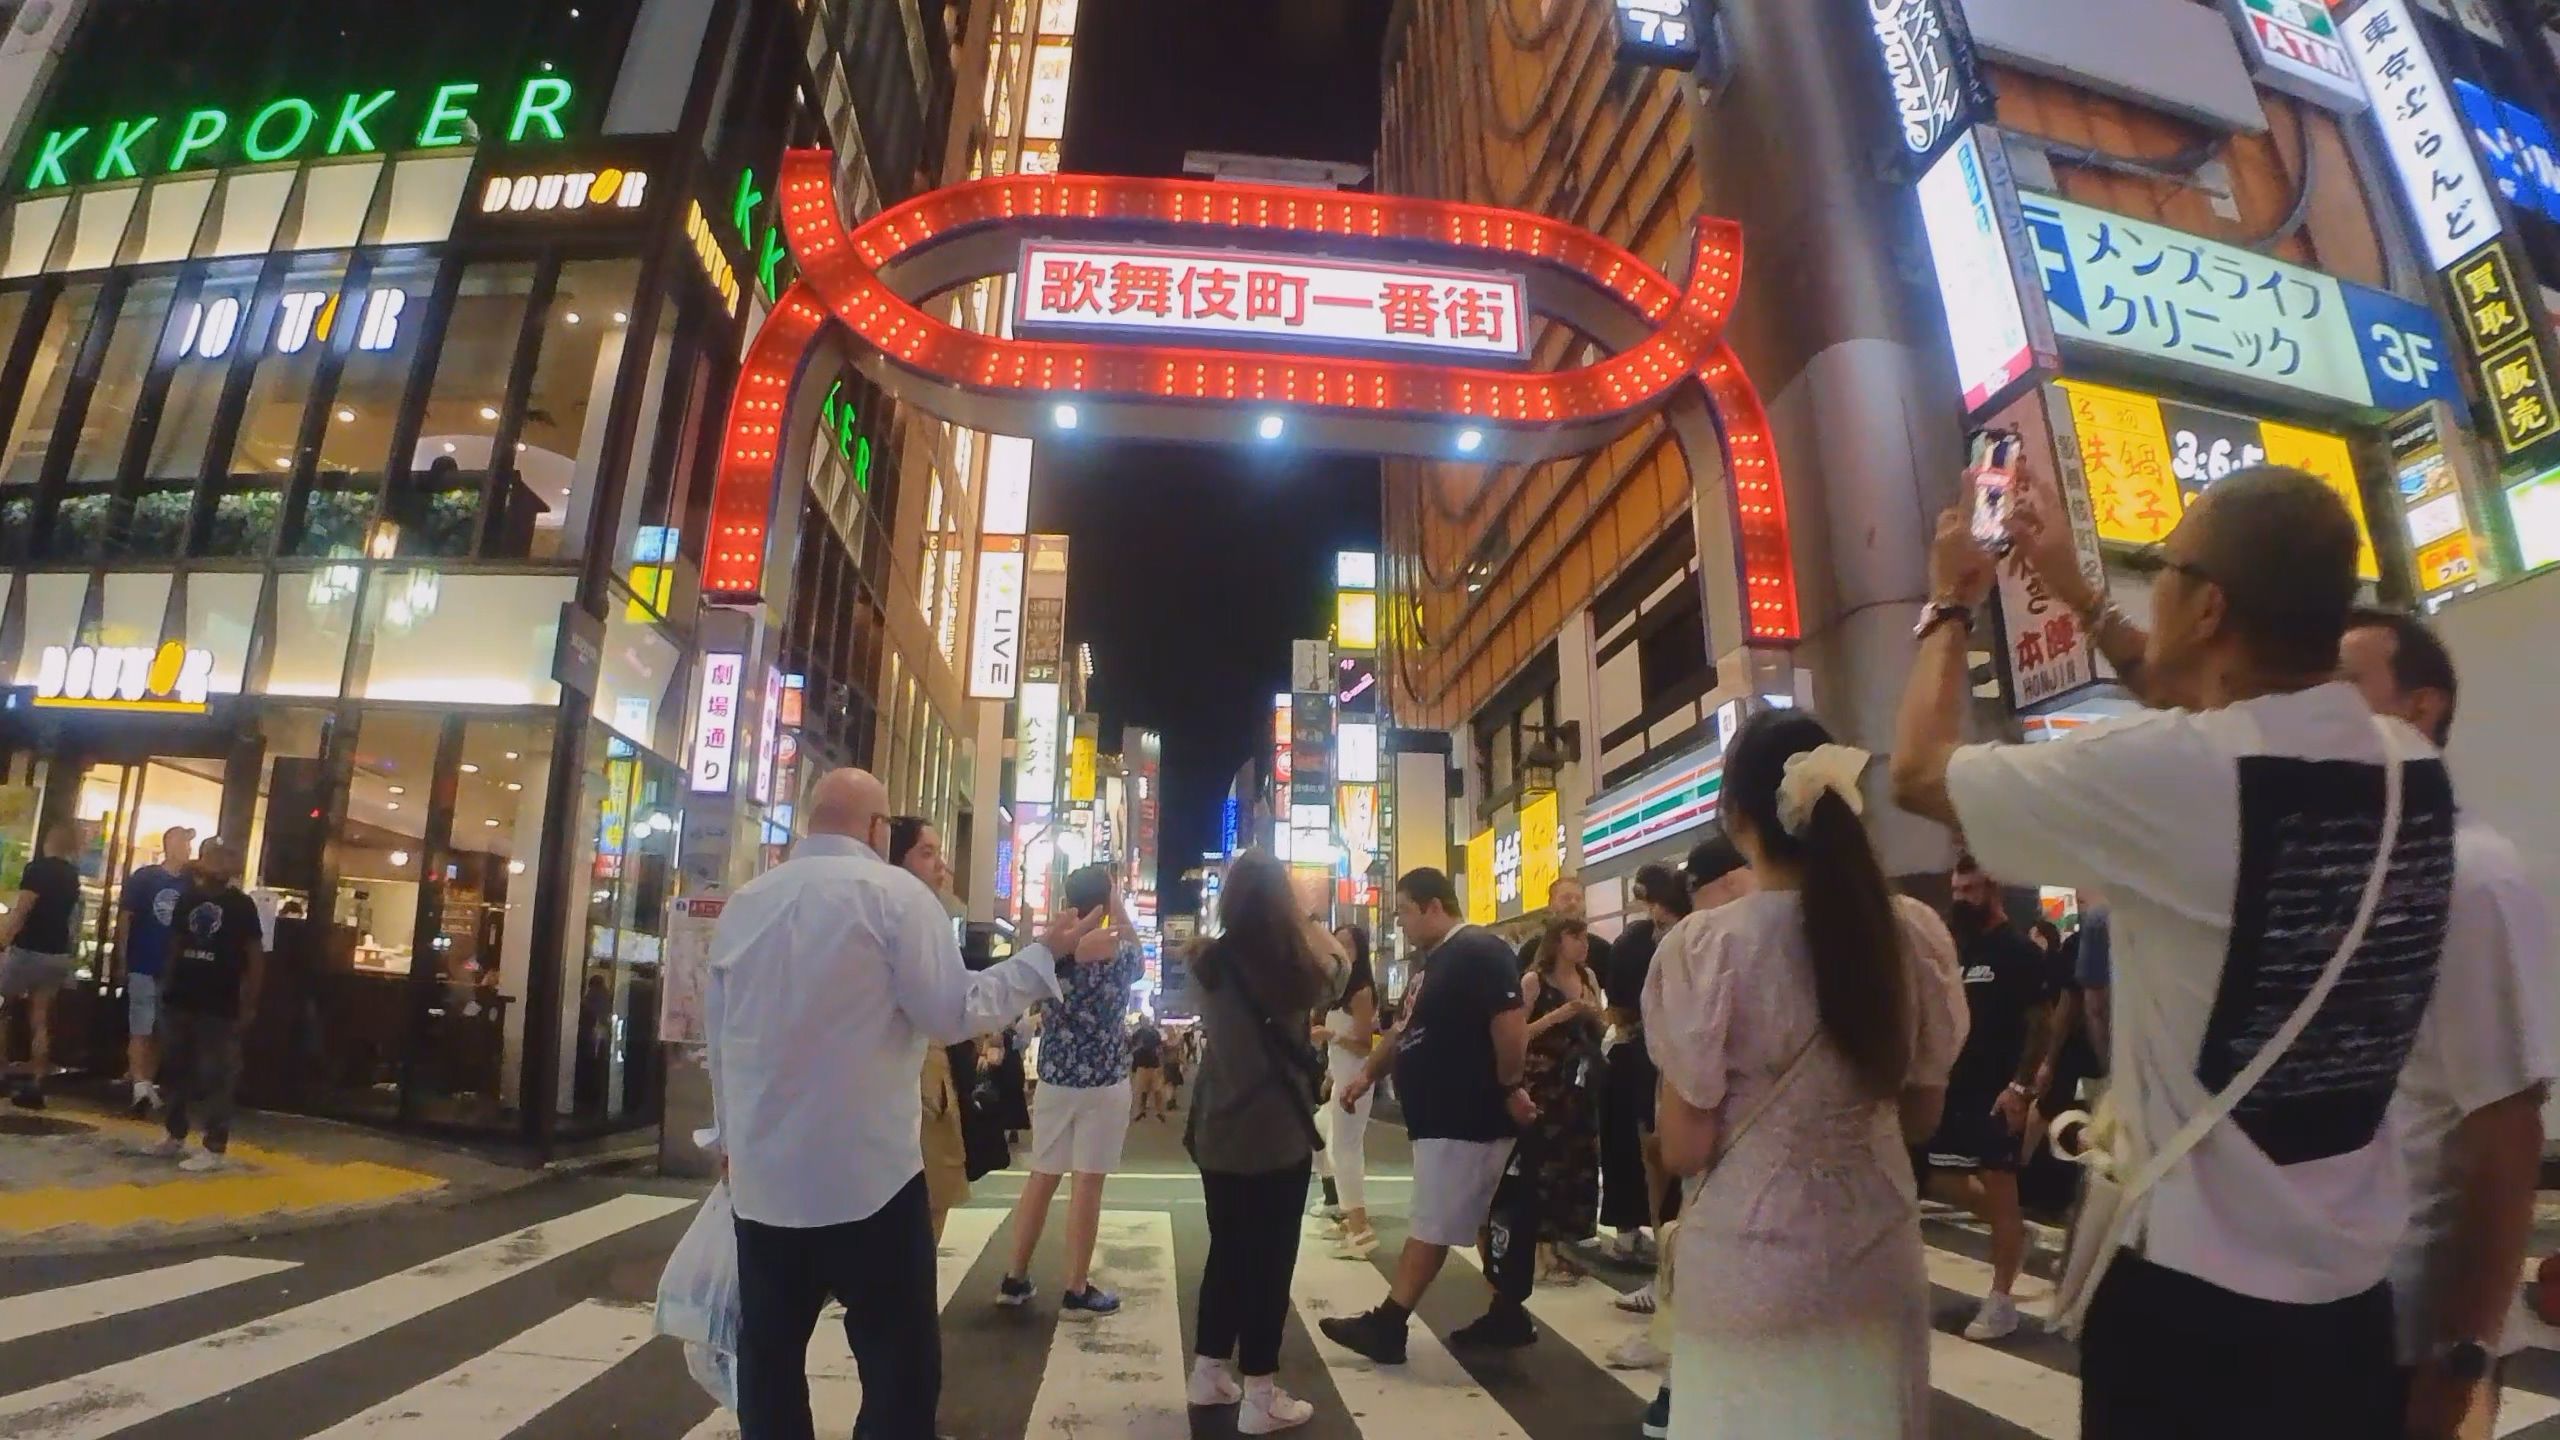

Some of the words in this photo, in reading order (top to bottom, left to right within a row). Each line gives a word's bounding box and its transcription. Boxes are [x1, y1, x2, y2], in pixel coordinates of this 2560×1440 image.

[1628, 9, 1687, 47] 7F
[2261, 15, 2353, 80] ATM
[26, 76, 573, 190] KKPOKER
[2360, 9, 2477, 241] 東京ぶらんど
[482, 168, 648, 213] DOUTOR
[1040, 258, 1505, 342] 歌舞伎町一番街
[2087, 219, 2322, 321] メンズライフ
[2463, 261, 2516, 339] 買取
[179, 288, 406, 359] OTR
[2097, 284, 2302, 377] クリニック
[2368, 322, 2440, 390] 3F
[2496, 363, 2548, 439] 販売
[37, 639, 214, 704] DOUTOR
[989, 608, 1012, 686] LIVE
[1027, 666, 1054, 679] 3F
[701, 663, 734, 781] 劇場通り
